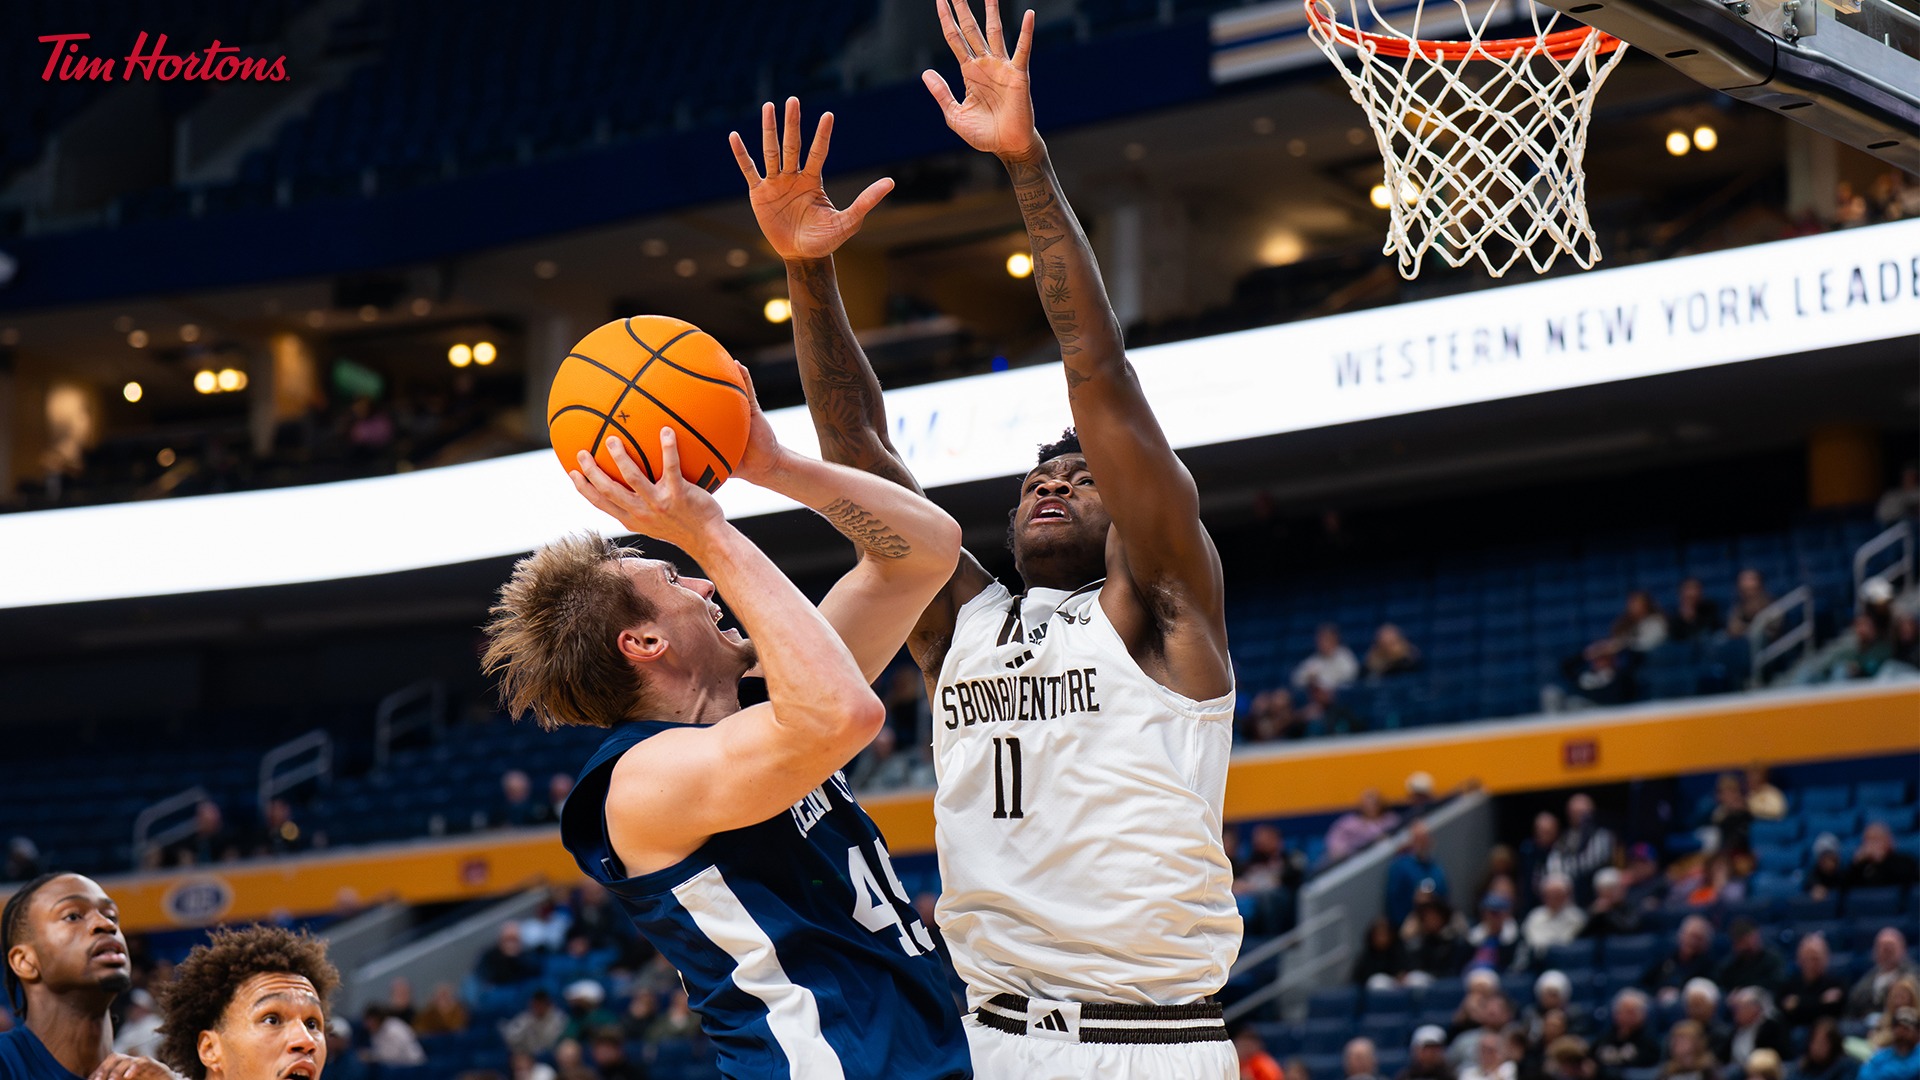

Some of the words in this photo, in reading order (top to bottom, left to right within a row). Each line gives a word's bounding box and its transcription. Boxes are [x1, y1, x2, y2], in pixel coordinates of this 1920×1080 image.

[1333, 321, 1522, 388] WESTERN
[1546, 303, 1638, 352] NEW
[1661, 281, 1769, 335] YORK
[992, 737, 1024, 819] 11
